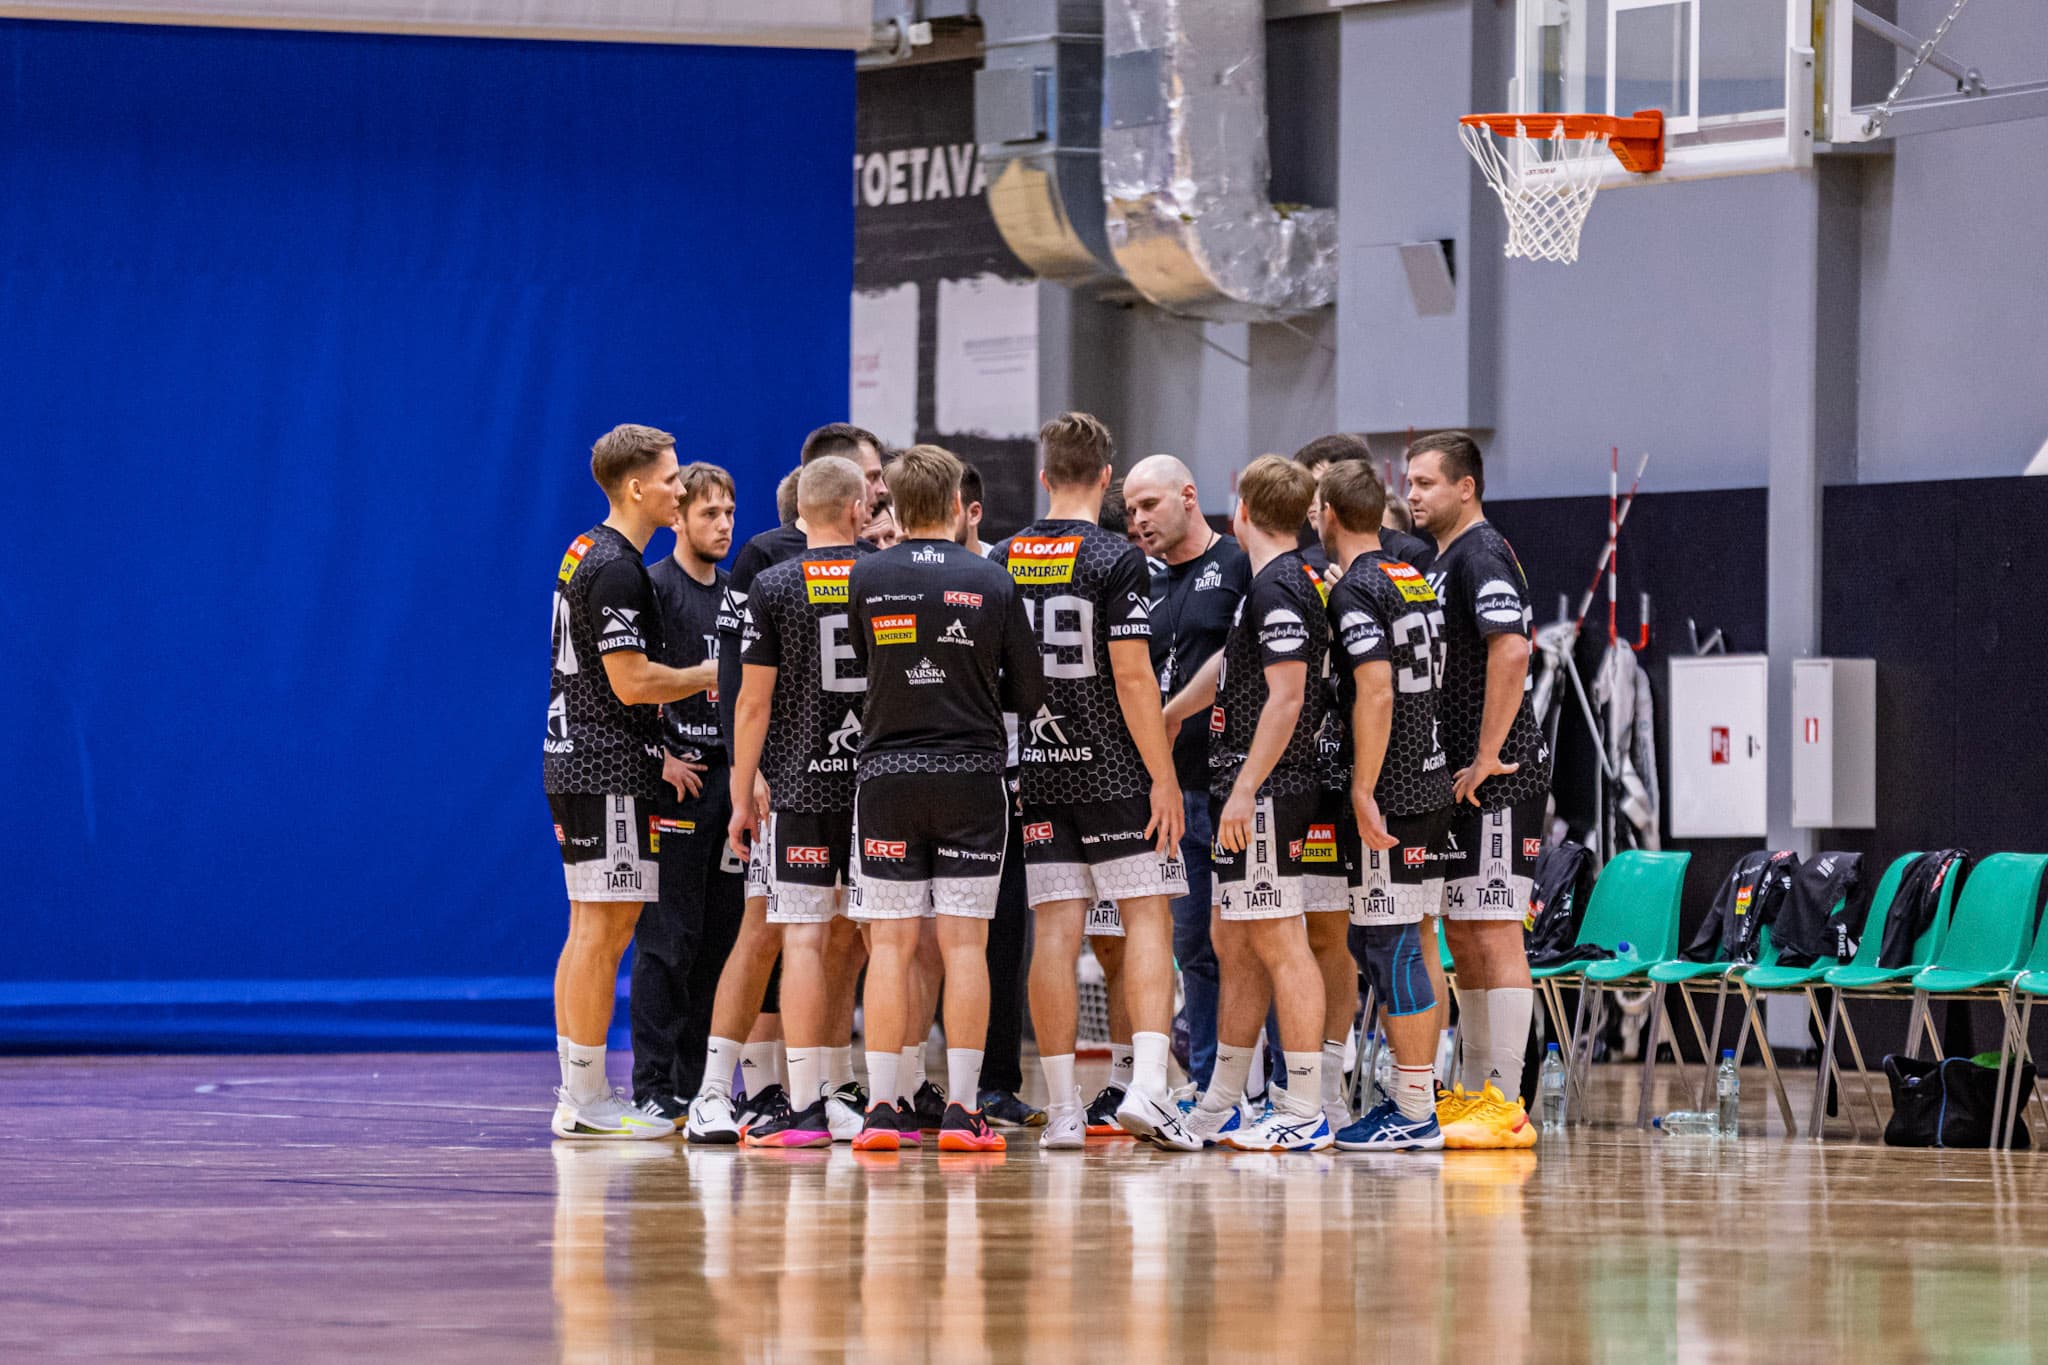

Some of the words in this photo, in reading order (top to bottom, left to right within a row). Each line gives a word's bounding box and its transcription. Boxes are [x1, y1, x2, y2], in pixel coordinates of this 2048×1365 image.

[1024, 541, 1075, 555] LOXAM
[912, 551, 944, 563] TARTU
[820, 566, 849, 576] LOX
[1011, 564, 1070, 577] RAMIRENT
[1195, 573, 1222, 592] TARTU
[946, 591, 981, 606] KRC
[880, 619, 912, 628] LOXAM
[1047, 746, 1093, 762] HAUS
[807, 759, 848, 773] AGRI
[867, 841, 906, 858] KRC
[604, 870, 642, 890] TARTU
[1159, 862, 1188, 882] TARTU
[1244, 888, 1282, 910] TARTU
[1476, 886, 1514, 907] TARTU
[1361, 896, 1395, 915] TARTU
[1088, 907, 1120, 926] TARTU
